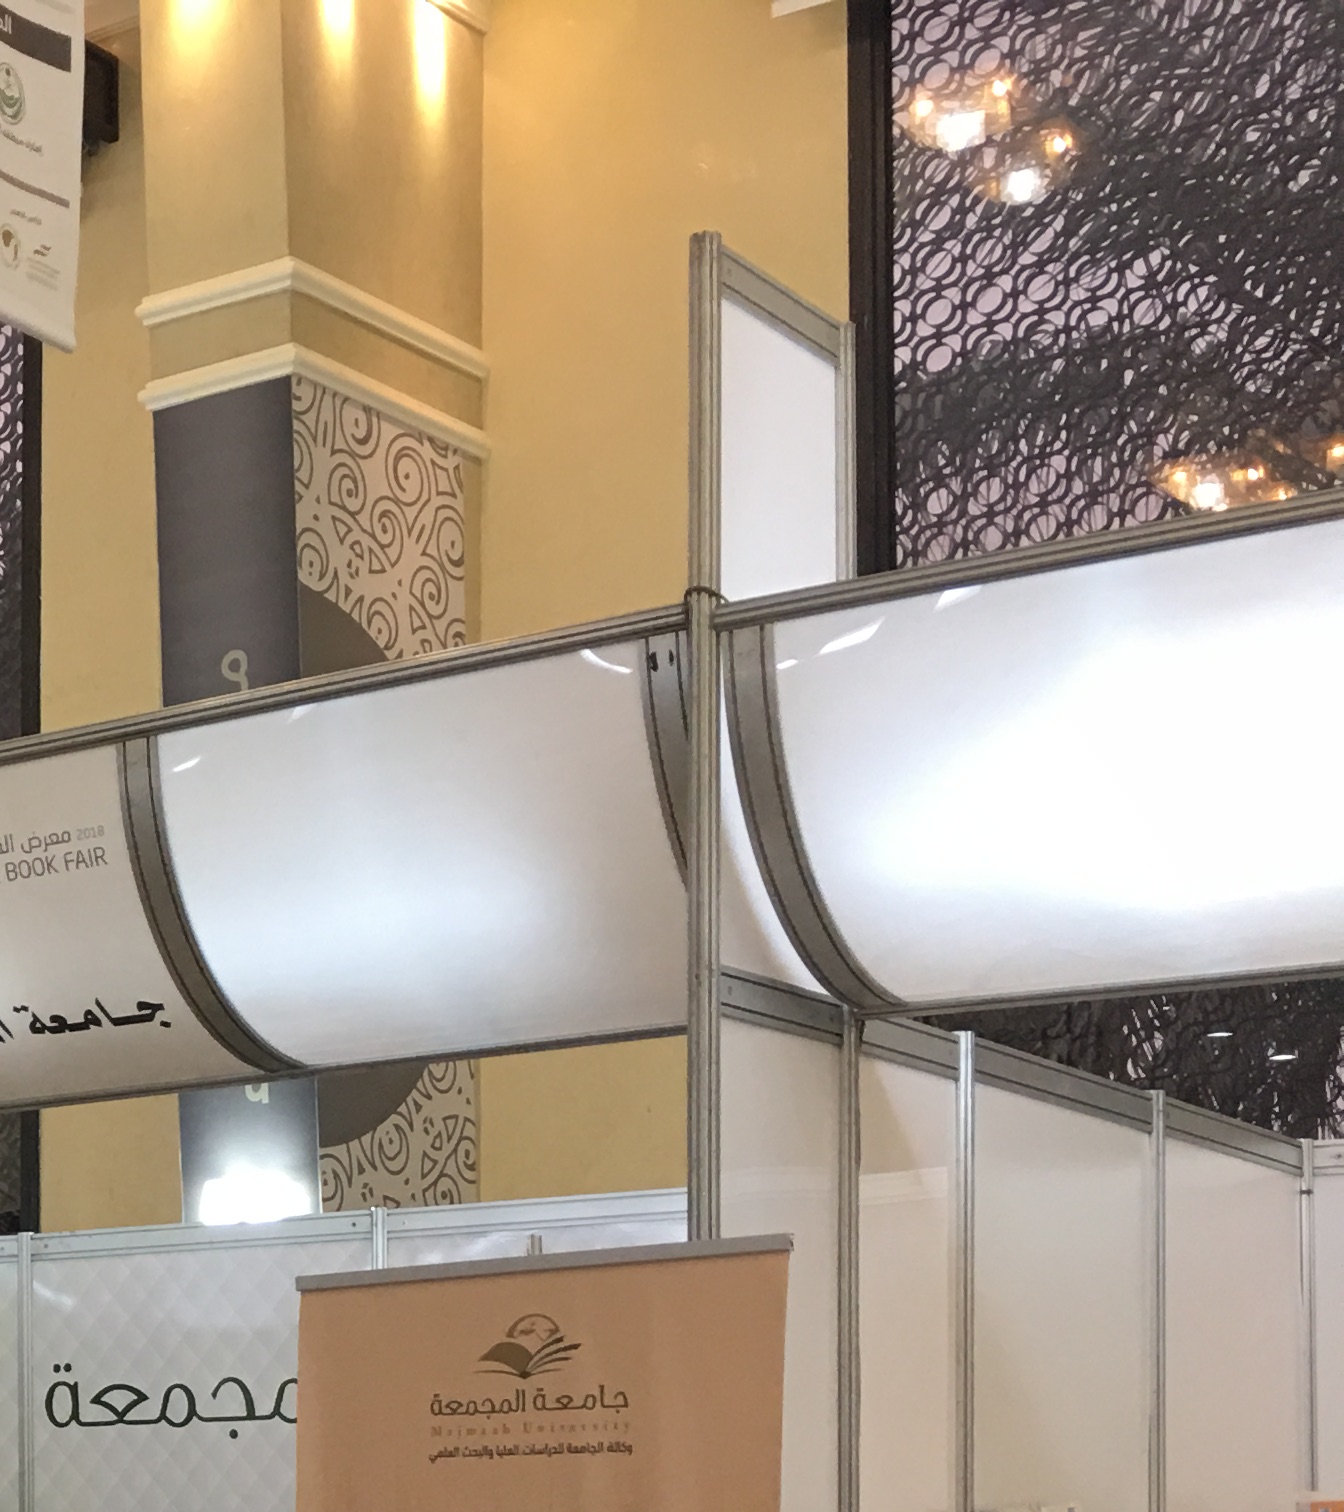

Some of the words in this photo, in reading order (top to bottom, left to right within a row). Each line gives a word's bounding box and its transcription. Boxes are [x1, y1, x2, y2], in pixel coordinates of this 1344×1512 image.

[21, 830, 72, 855] معرض
[75, 825, 105, 841] 2018
[5, 854, 59, 883] BOOK
[64, 846, 109, 873] FAIR
[12, 996, 172, 1036] جامعة
[45, 1362, 298, 1440] مجمعة
[429, 1388, 526, 1420] المجمعة
[532, 1384, 629, 1414] جامعة
